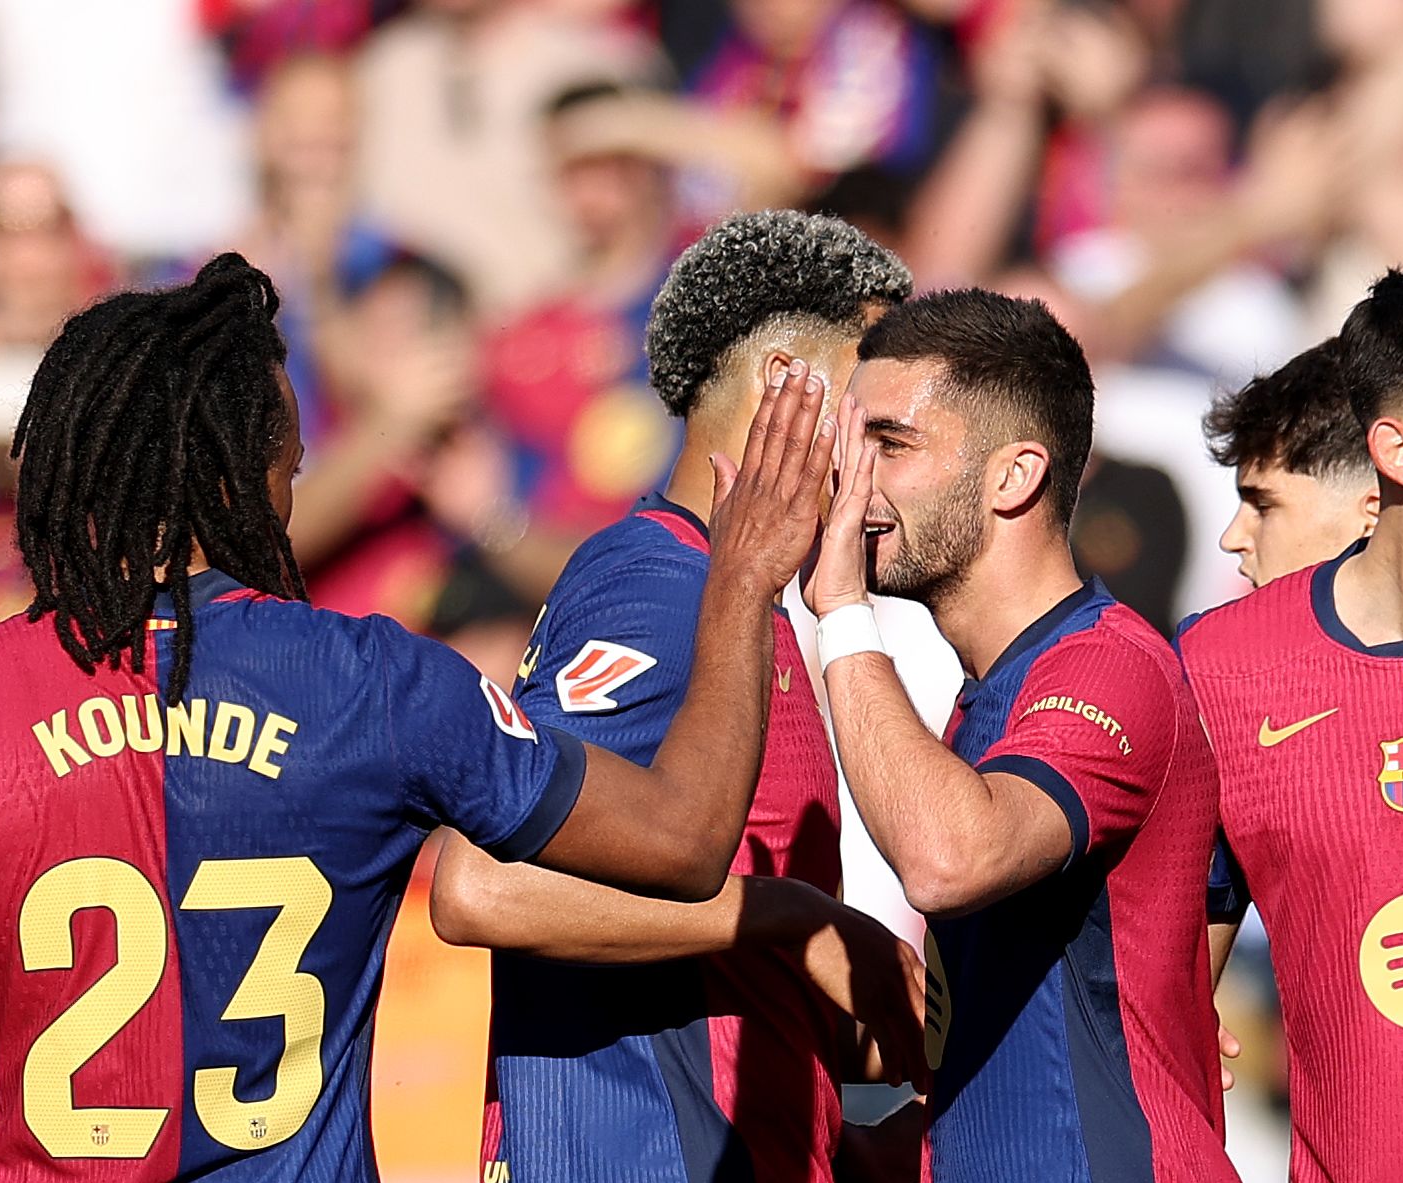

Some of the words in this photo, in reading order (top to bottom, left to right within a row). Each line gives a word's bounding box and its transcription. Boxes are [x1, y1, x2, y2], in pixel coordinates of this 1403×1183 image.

[32, 694, 298, 779] KOUNDE
[1118, 735, 1133, 756] tv
[18, 856, 333, 1158] 23
